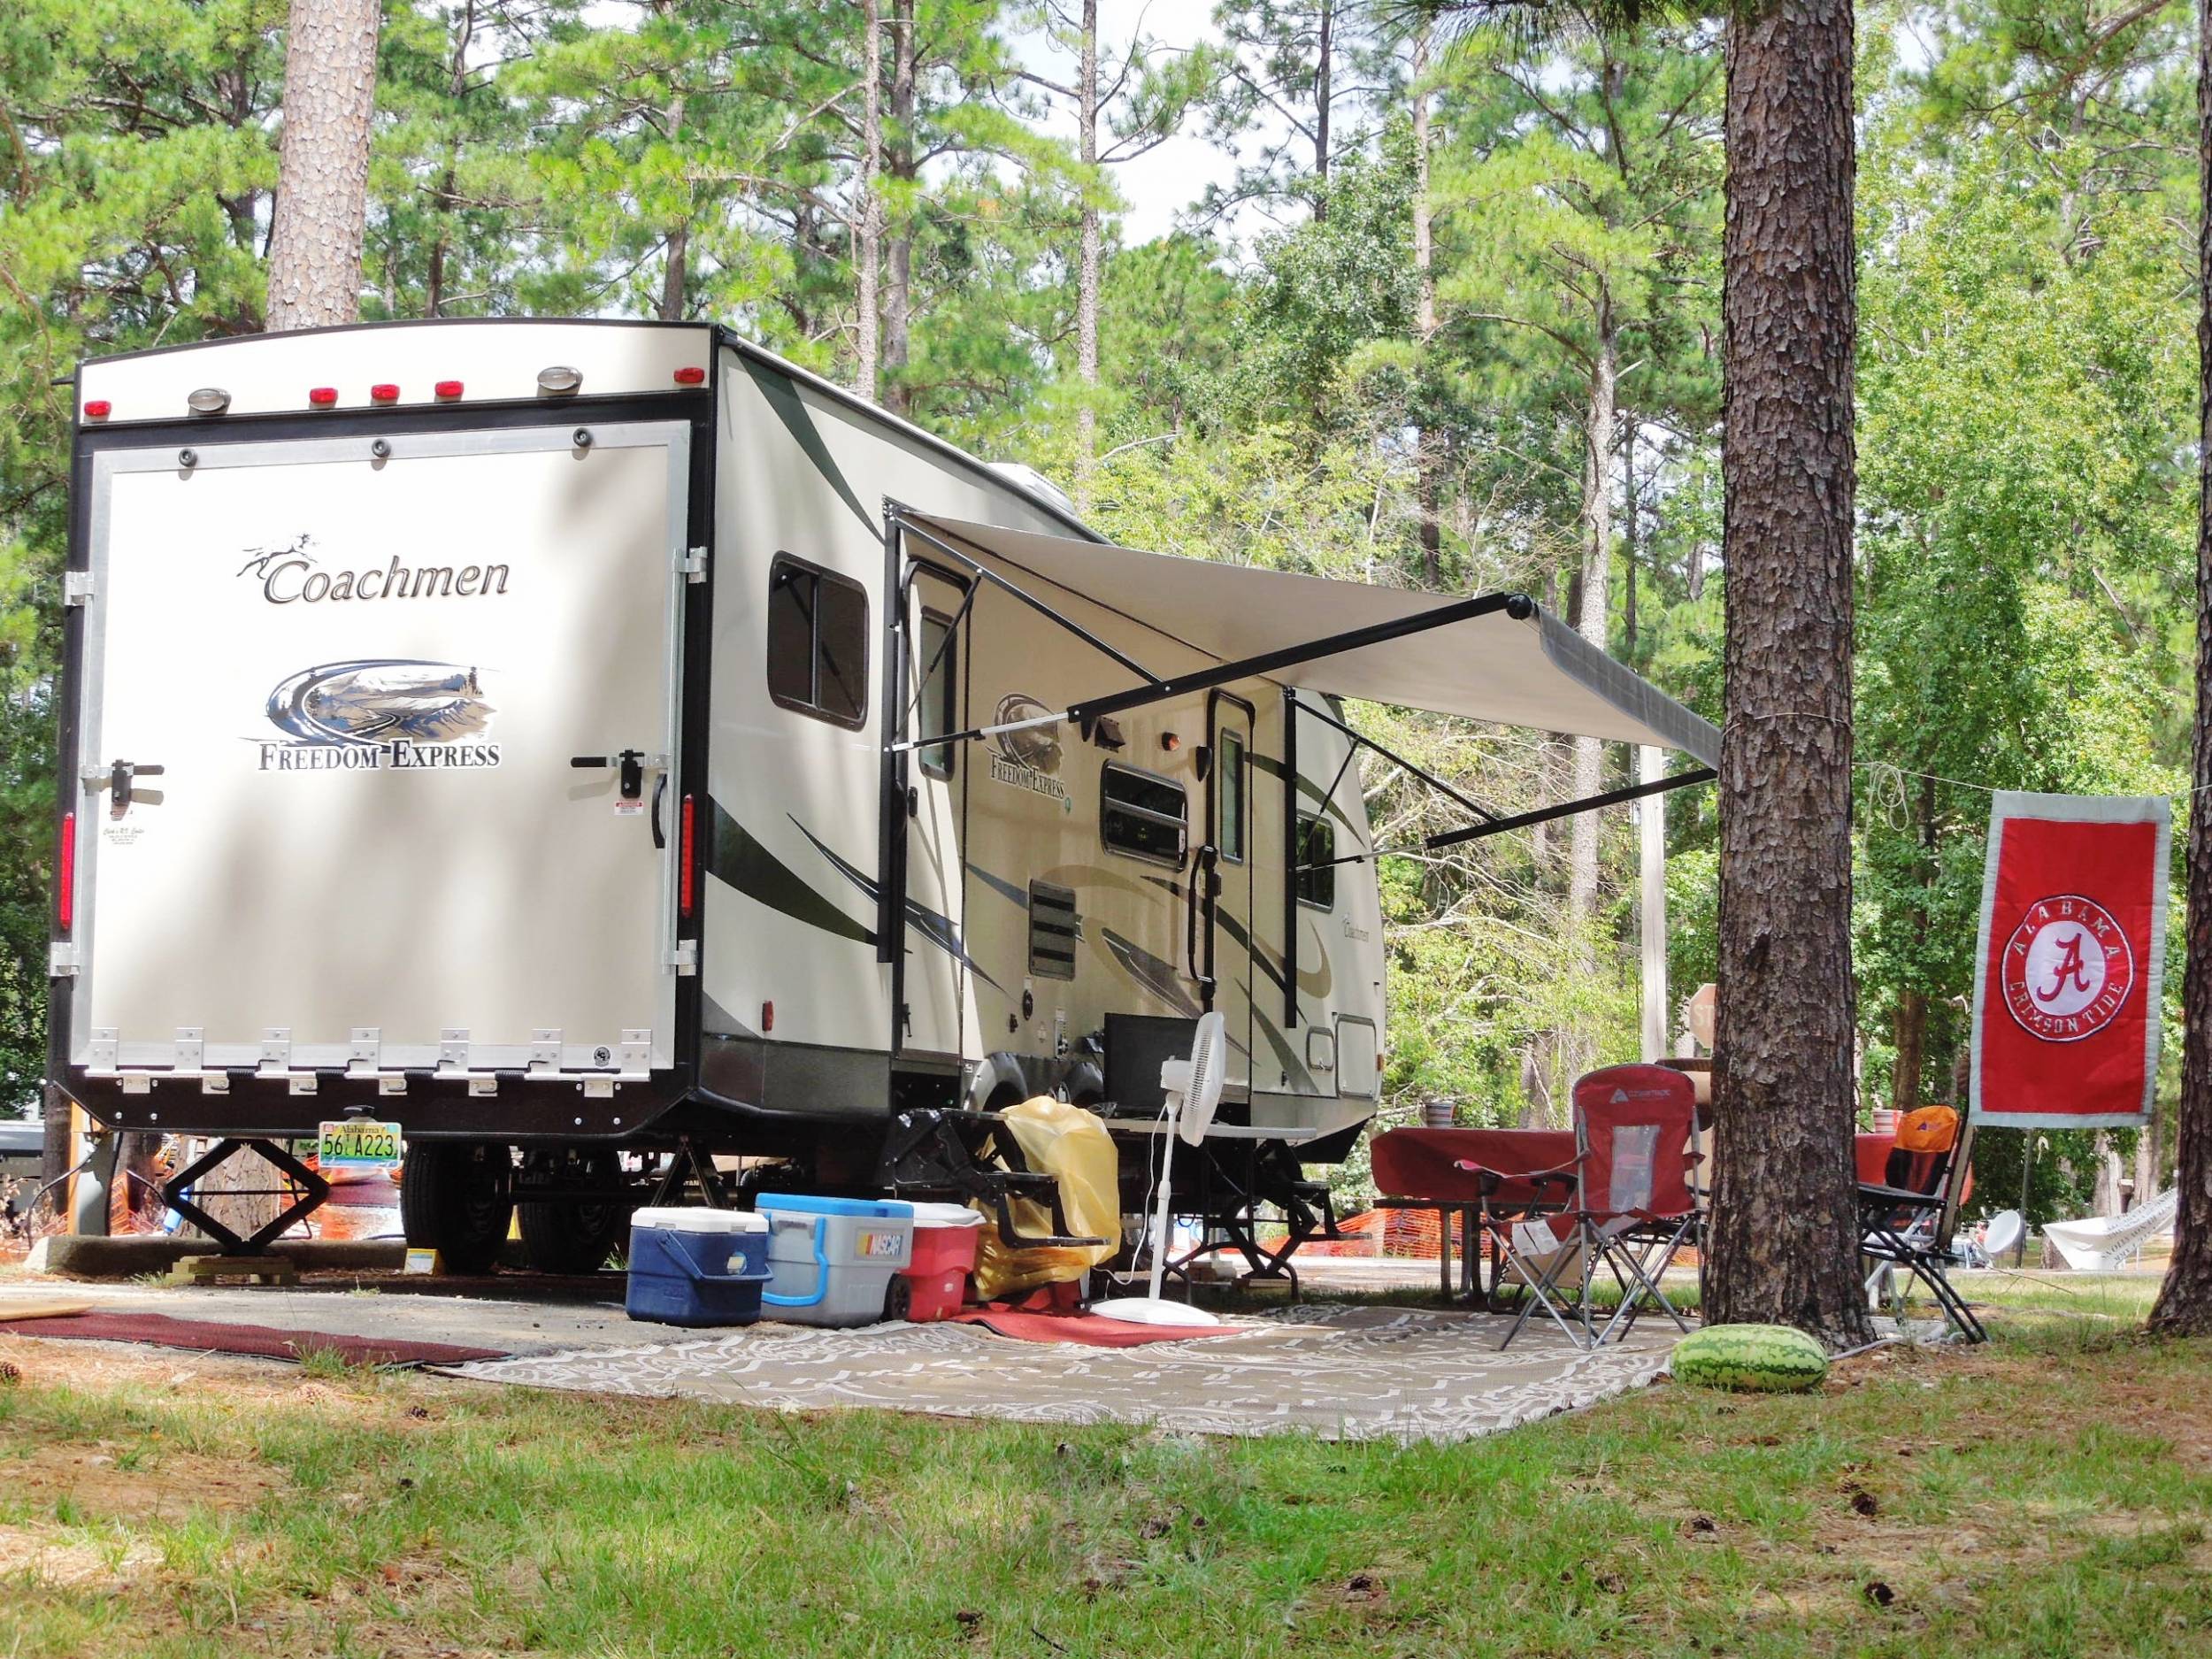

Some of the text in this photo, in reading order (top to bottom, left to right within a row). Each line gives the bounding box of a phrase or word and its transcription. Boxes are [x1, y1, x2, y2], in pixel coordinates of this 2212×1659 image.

[264, 555, 511, 604] Coachmen
[258, 740, 501, 771] FREEDOM EXPRESS
[991, 754, 1065, 800] FREEDOM EXPRESS
[2013, 901, 2122, 959] ALABAMA
[2036, 933, 2091, 1002] A
[2009, 980, 2124, 1033] CRIMSON TIDE
[340, 1125, 380, 1134] Alabama
[871, 1233, 901, 1256] NASCAR
